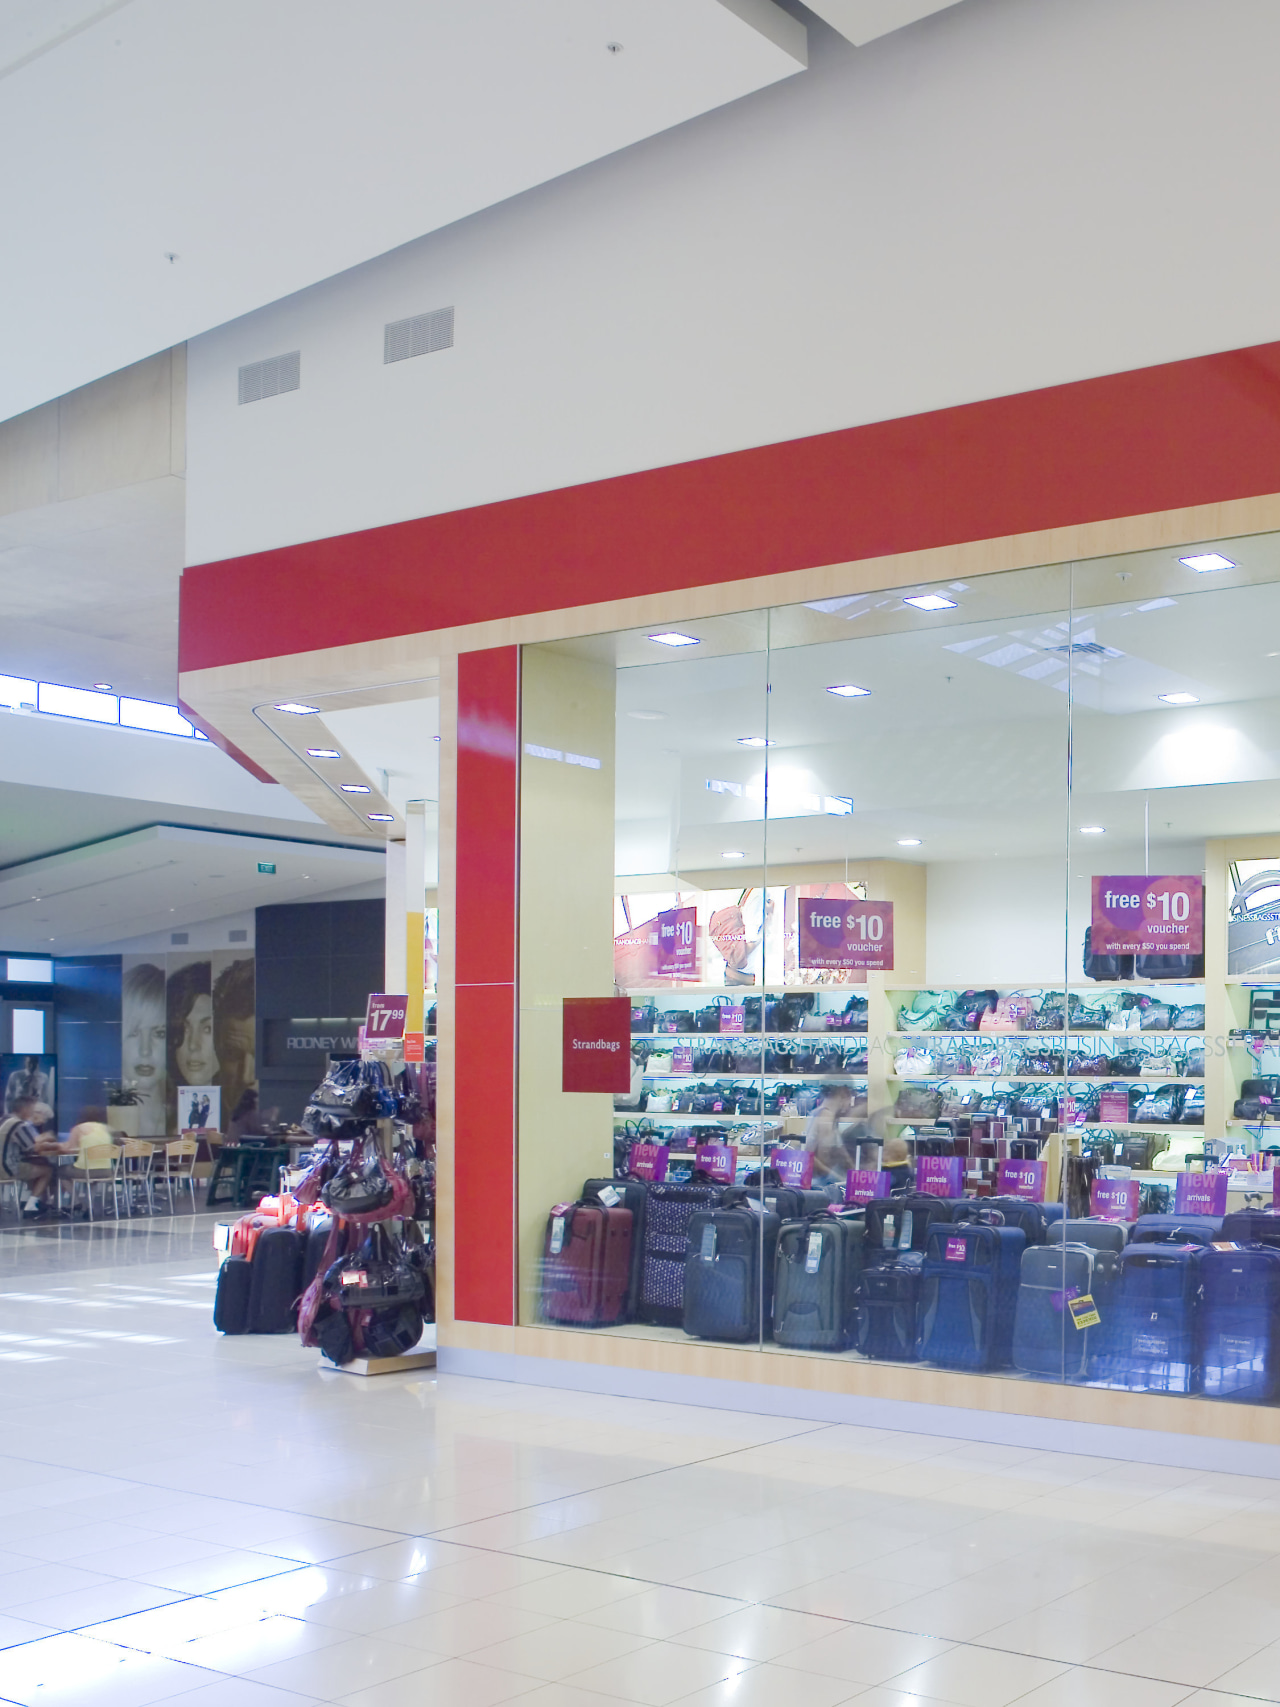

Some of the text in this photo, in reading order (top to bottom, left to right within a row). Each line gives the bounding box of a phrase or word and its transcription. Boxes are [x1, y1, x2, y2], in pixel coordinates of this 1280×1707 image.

[1105, 891, 1190, 921] free $10
[676, 921, 693, 945] $10
[810, 912, 884, 941] free $10
[1147, 923, 1189, 934] voucher
[847, 942, 883, 952] voucher
[1105, 942, 1190, 951] with every $50 you spend
[842, 958, 854, 966] $50
[854, 959, 865, 967] you
[866, 959, 884, 967] spend
[287, 1036, 339, 1049] RODNEY
[340, 1036, 359, 1049] W
[572, 1038, 621, 1052] Strandbags
[634, 1143, 659, 1157] new
[701, 1154, 726, 1168] free $10
[776, 1158, 803, 1173] free $10
[921, 1156, 952, 1170] new
[851, 1170, 880, 1184] new
[926, 1175, 947, 1183] arrivals
[1005, 1169, 1035, 1185] free $10
[1182, 1173, 1217, 1189] new
[854, 1189, 874, 1197] arrivals
[1097, 1190, 1128, 1205] free $10
[1186, 1194, 1211, 1202] arrivals
